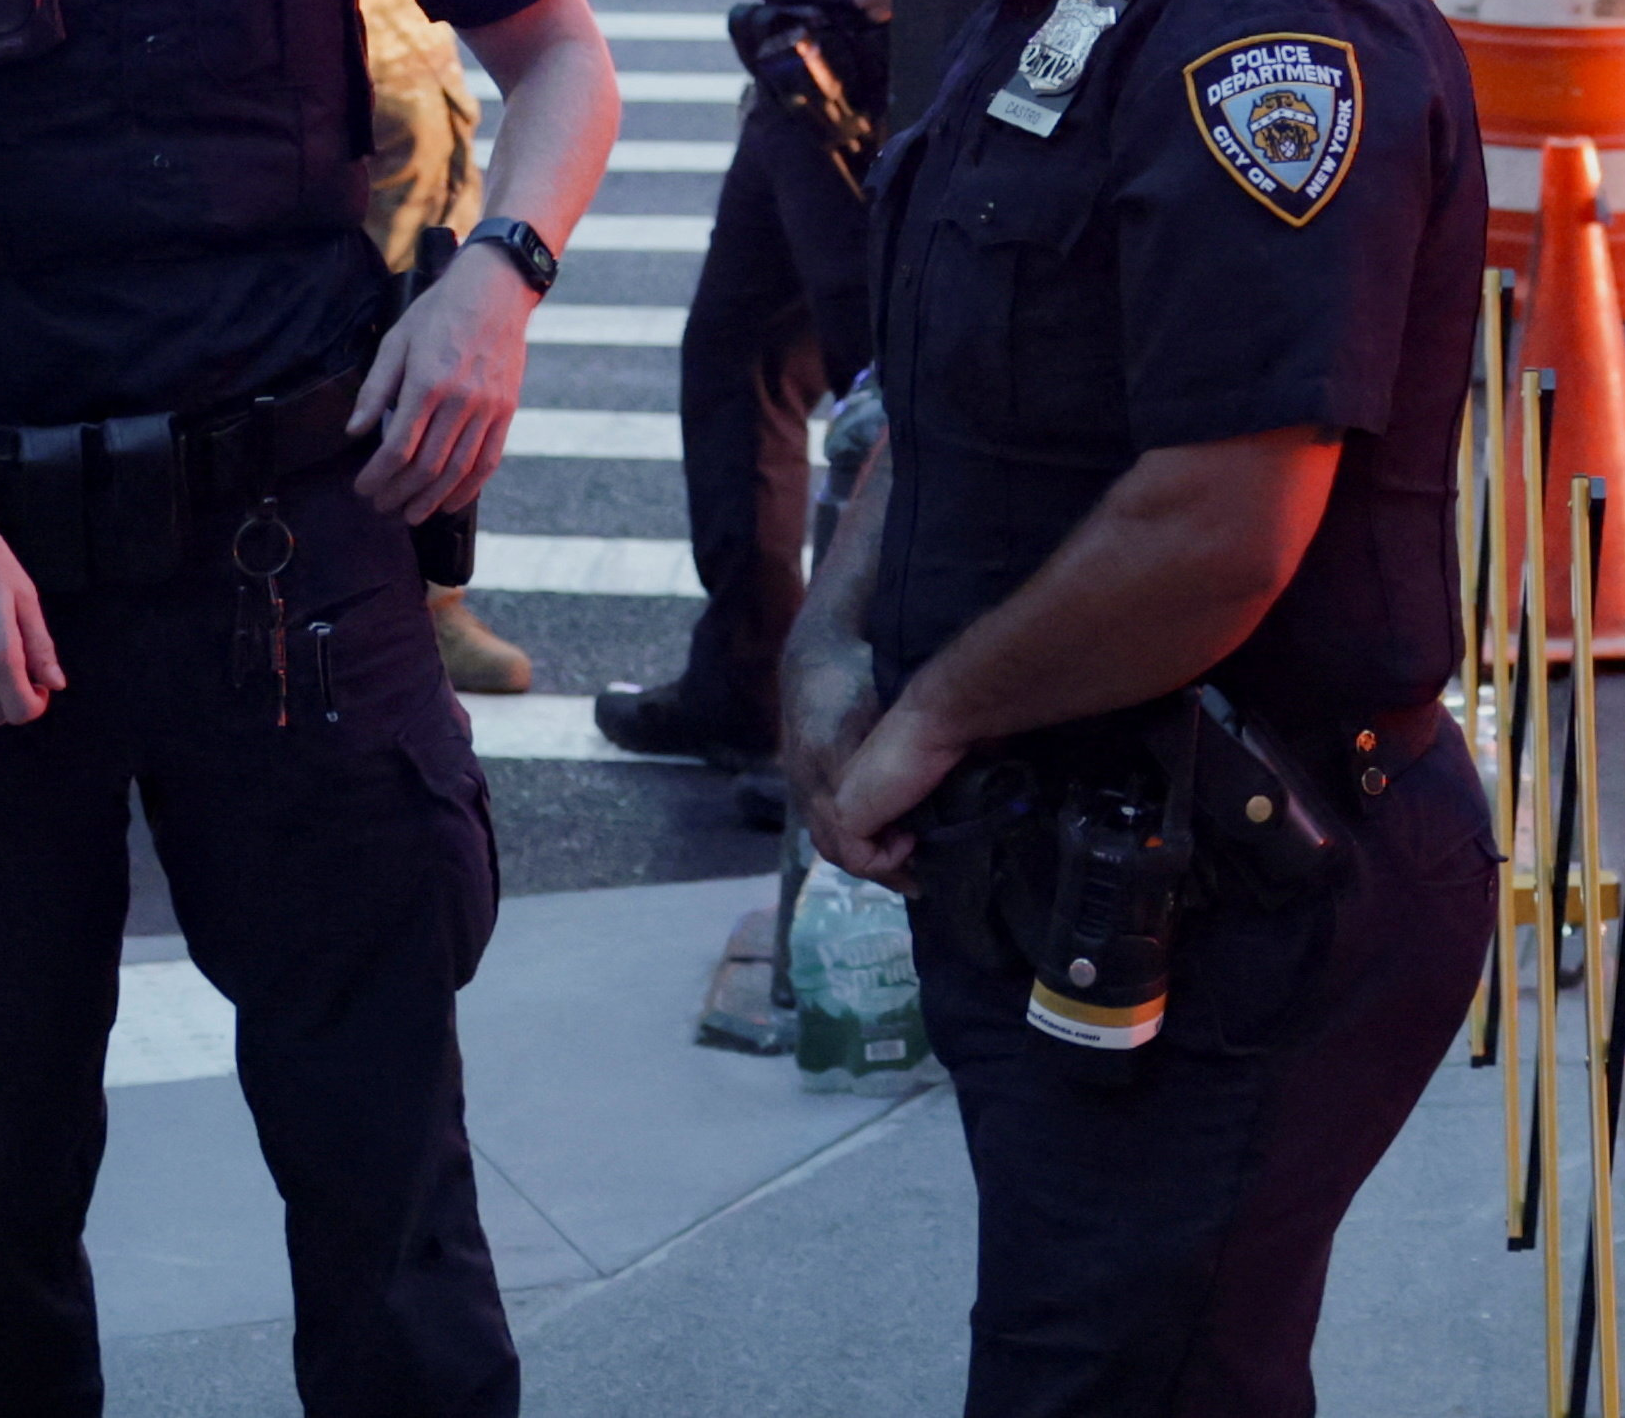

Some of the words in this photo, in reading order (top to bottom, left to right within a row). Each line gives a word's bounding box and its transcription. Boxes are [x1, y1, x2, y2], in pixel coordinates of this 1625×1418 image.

[1231, 45, 1312, 74] POLICE
[1207, 63, 1343, 106] DEPARTMENT
[1005, 101, 1042, 125] CASTRO
[1212, 125, 1252, 167] CITY
[1247, 166, 1277, 194] OF
[1305, 155, 1337, 199] NEW
[1328, 98, 1353, 155] YORK
